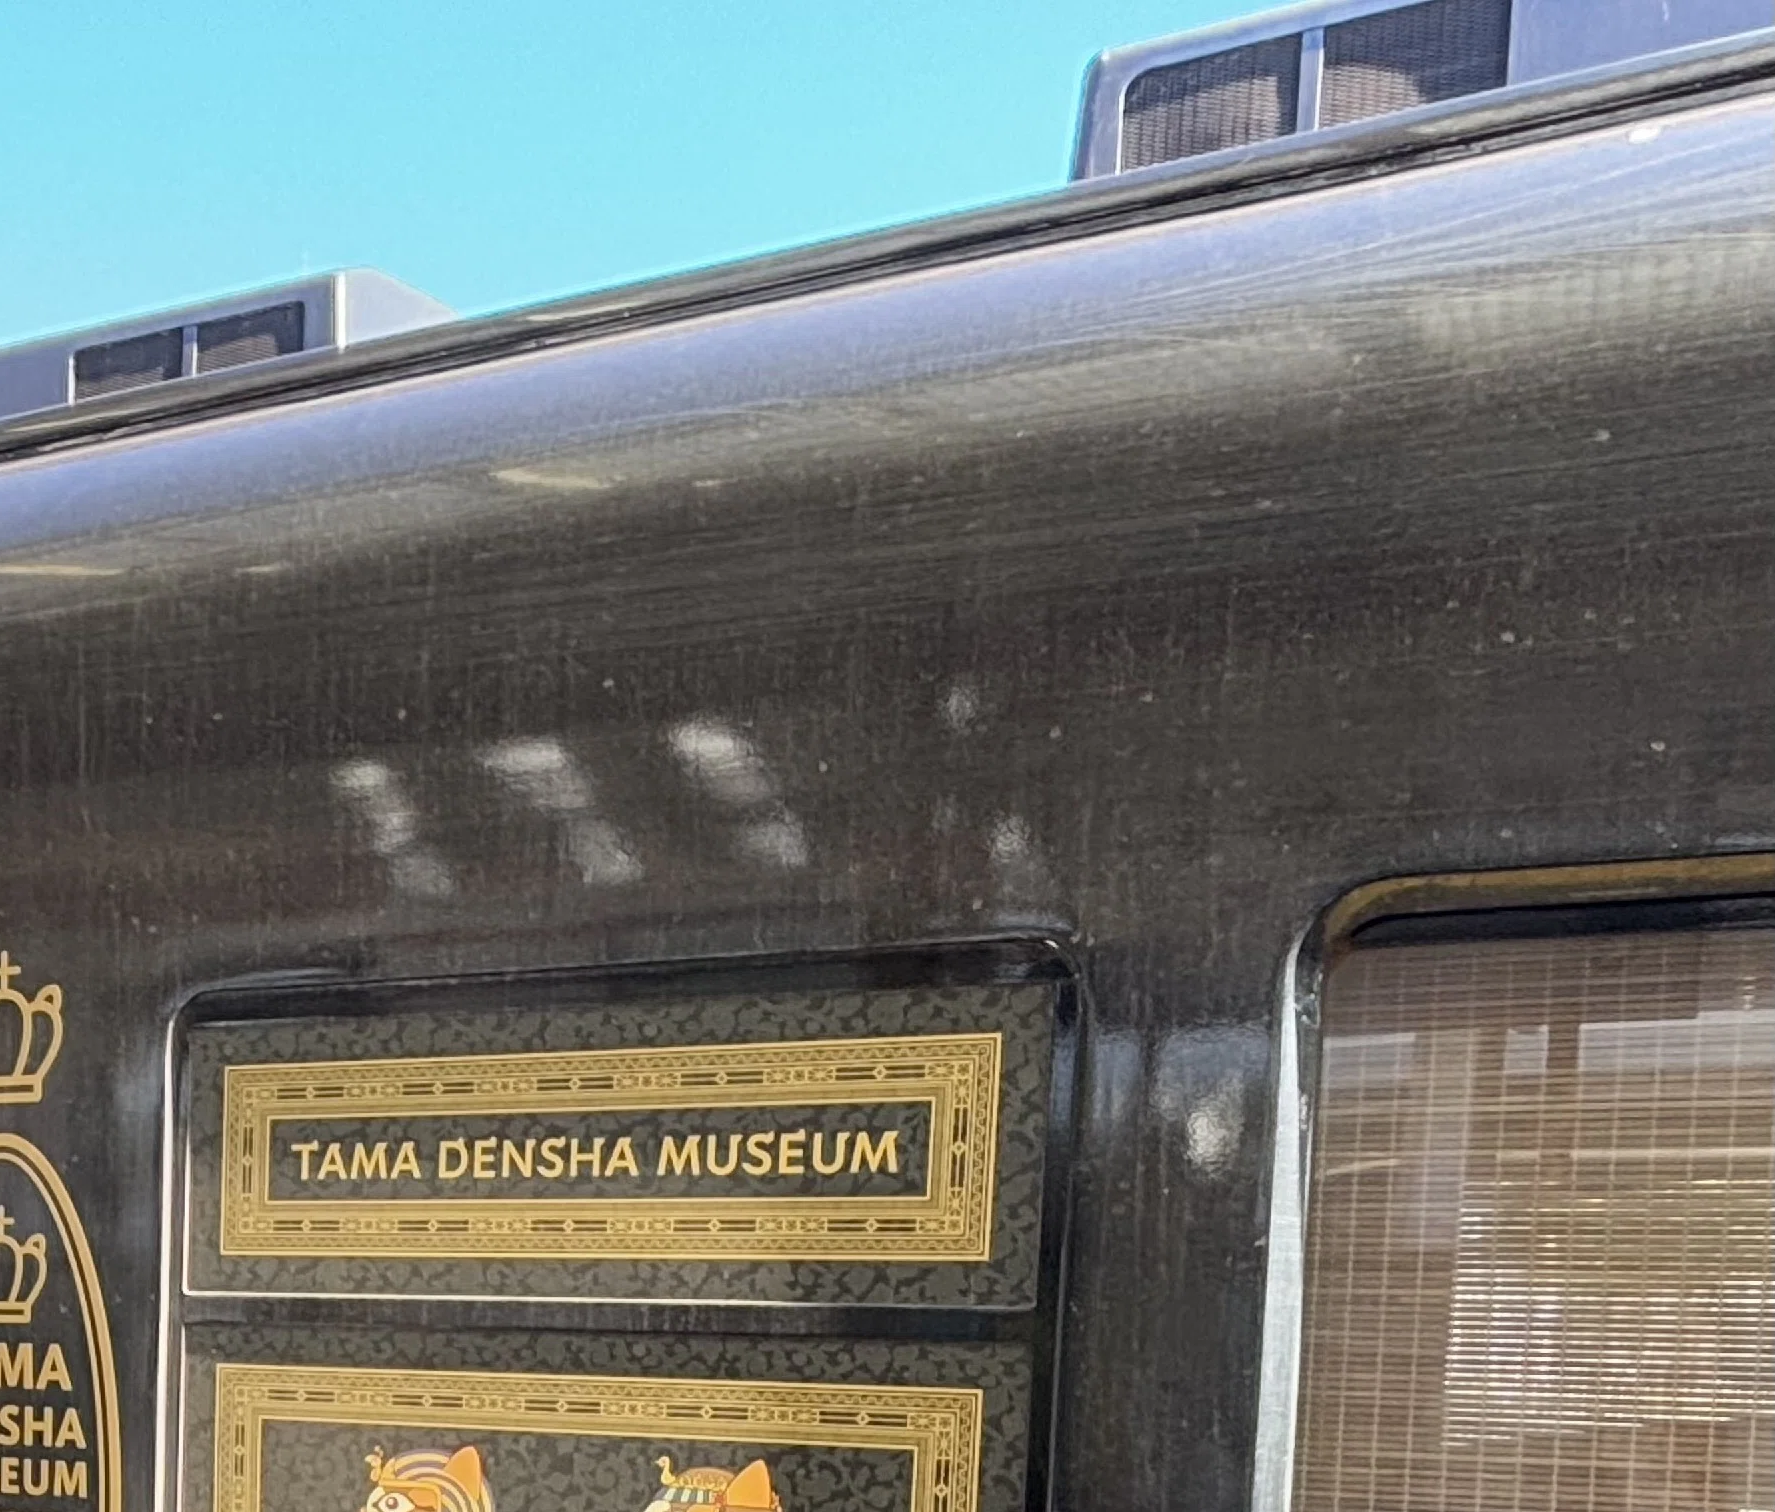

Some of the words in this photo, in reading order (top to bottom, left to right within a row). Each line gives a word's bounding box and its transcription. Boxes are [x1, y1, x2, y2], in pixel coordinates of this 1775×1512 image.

[291, 1139, 422, 1181] TAMA
[437, 1135, 639, 1178] DENSHA
[656, 1129, 900, 1176] MUSEUM
